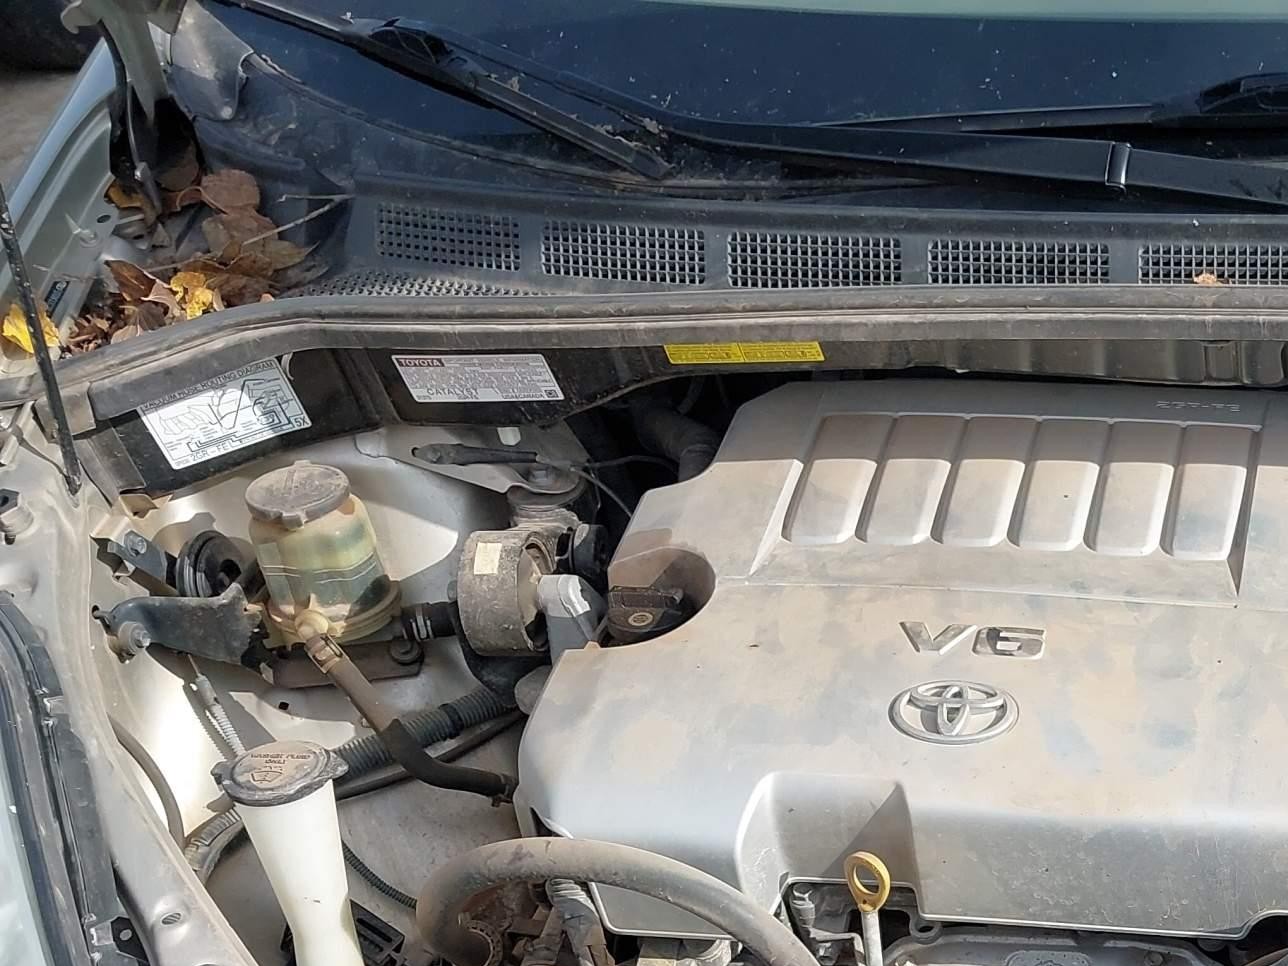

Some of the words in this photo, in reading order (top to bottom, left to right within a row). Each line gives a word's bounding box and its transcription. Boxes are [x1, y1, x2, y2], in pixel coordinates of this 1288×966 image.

[400, 358, 441, 367] TOYOTA
[427, 387, 479, 397] CATALYST
[295, 416, 309, 427] 5X
[899, 621, 1047, 661] V6
